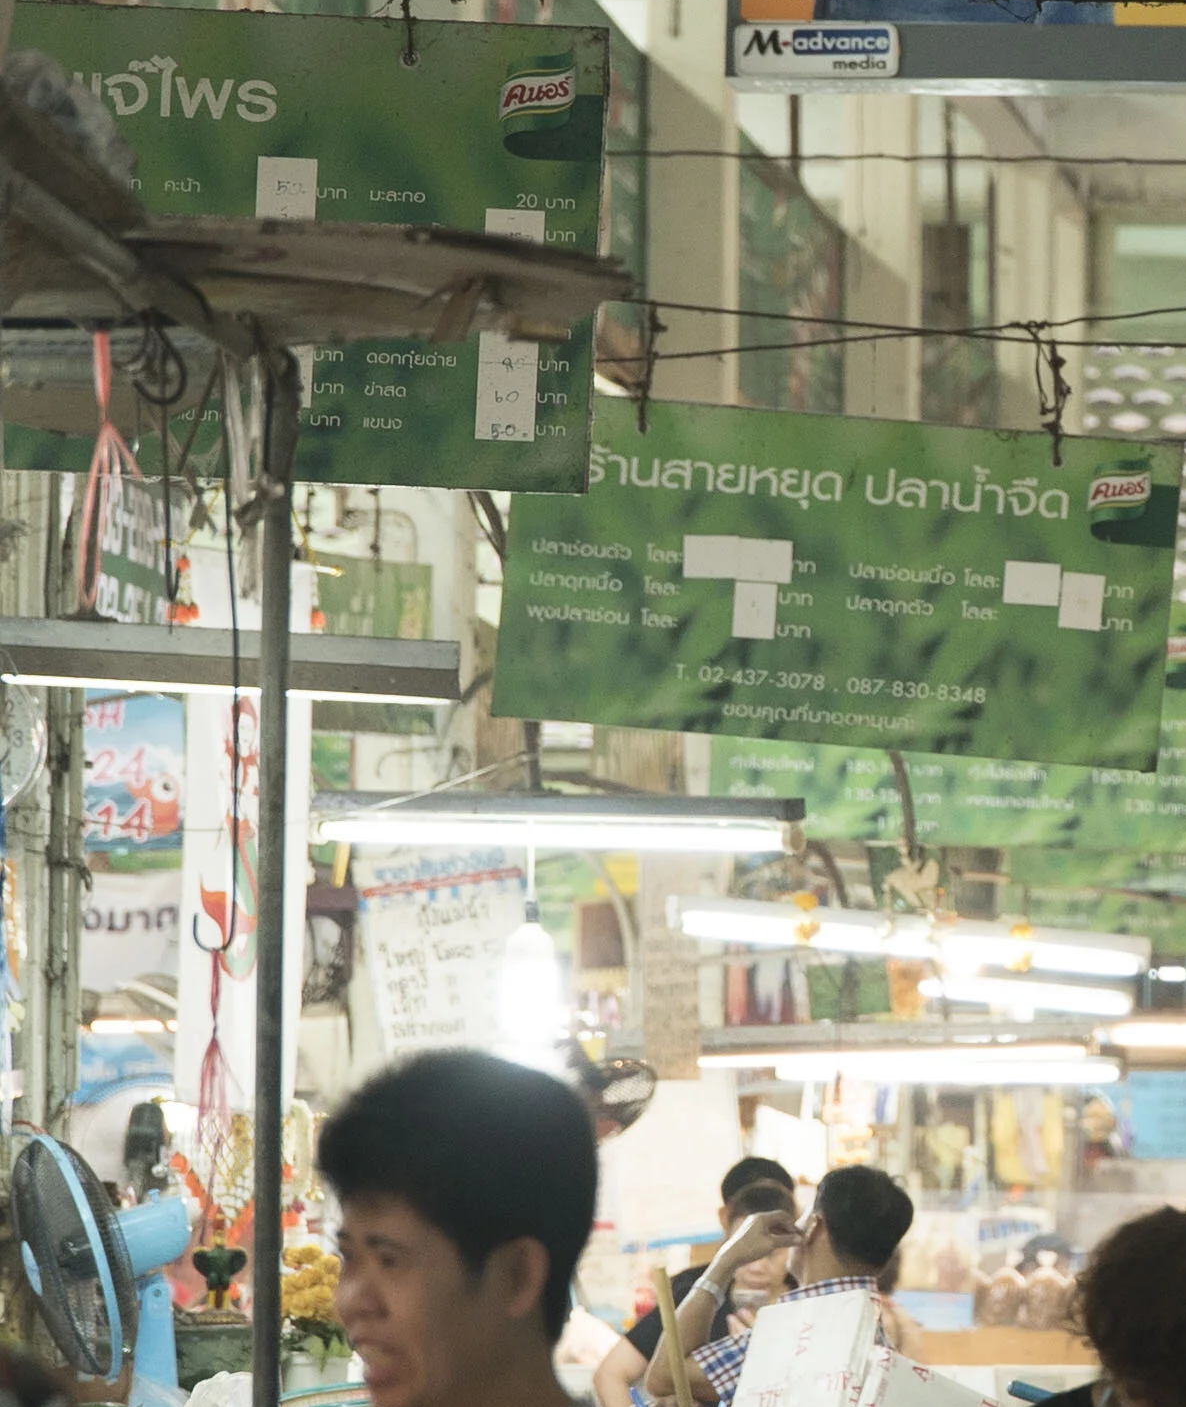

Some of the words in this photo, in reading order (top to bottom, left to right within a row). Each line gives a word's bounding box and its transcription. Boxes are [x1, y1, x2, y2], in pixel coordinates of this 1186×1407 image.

[832, 56, 887, 72] media
[164, 176, 201, 194] คะน้า
[317, 187, 347, 200] บาท
[369, 188, 426, 205] มะละกอ
[516, 194, 538, 209] 20
[545, 196, 576, 210] บาท
[545, 230, 576, 243] บาท
[313, 350, 344, 363] บาท
[539, 359, 570, 373] บาท
[313, 381, 344, 395] บาท
[537, 392, 567, 405] บาท
[309, 414, 341, 428] บาท
[536, 424, 566, 437] บาท
[588, 444, 842, 510] ร้านสายหยุด
[865, 465, 1068, 520] ปลาน้ำจืด
[793, 557, 816, 573] าท
[778, 588, 813, 606] บาท
[776, 622, 811, 638] บาท
[699, 665, 826, 692] 02-437-3078
[846, 676, 987, 705] 087-830-8348
